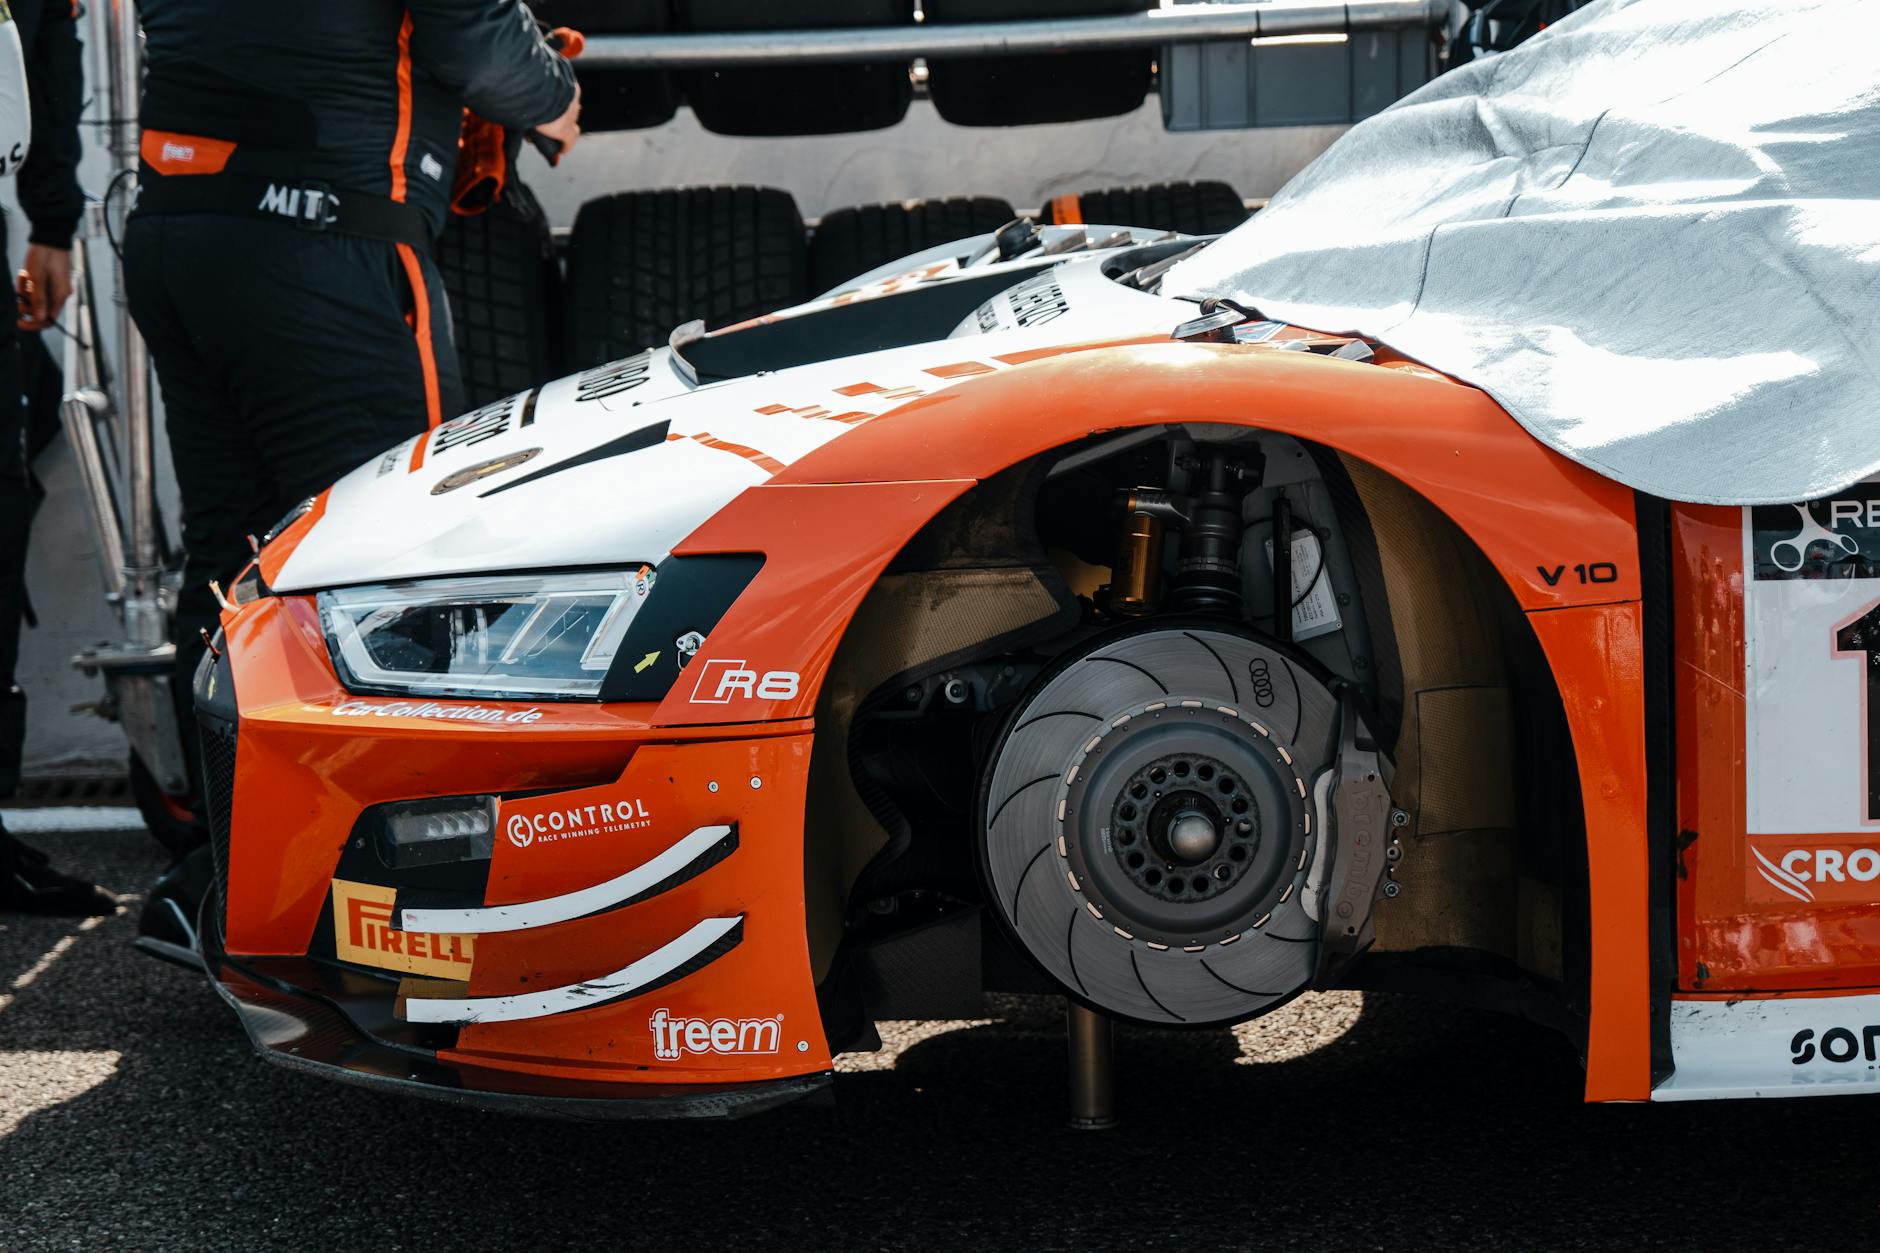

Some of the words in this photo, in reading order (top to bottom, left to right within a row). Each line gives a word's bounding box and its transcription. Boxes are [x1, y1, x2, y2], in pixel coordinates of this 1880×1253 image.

[712, 668, 801, 701] R8
[533, 799, 649, 833] CONTROL
[537, 834, 558, 843] RACE
[561, 828, 600, 840] WINNING
[603, 820, 651, 833] TELEMETRY
[1780, 848, 1880, 883] CRO
[347, 897, 475, 965] PIRELL
[650, 1008, 781, 1060] freem
